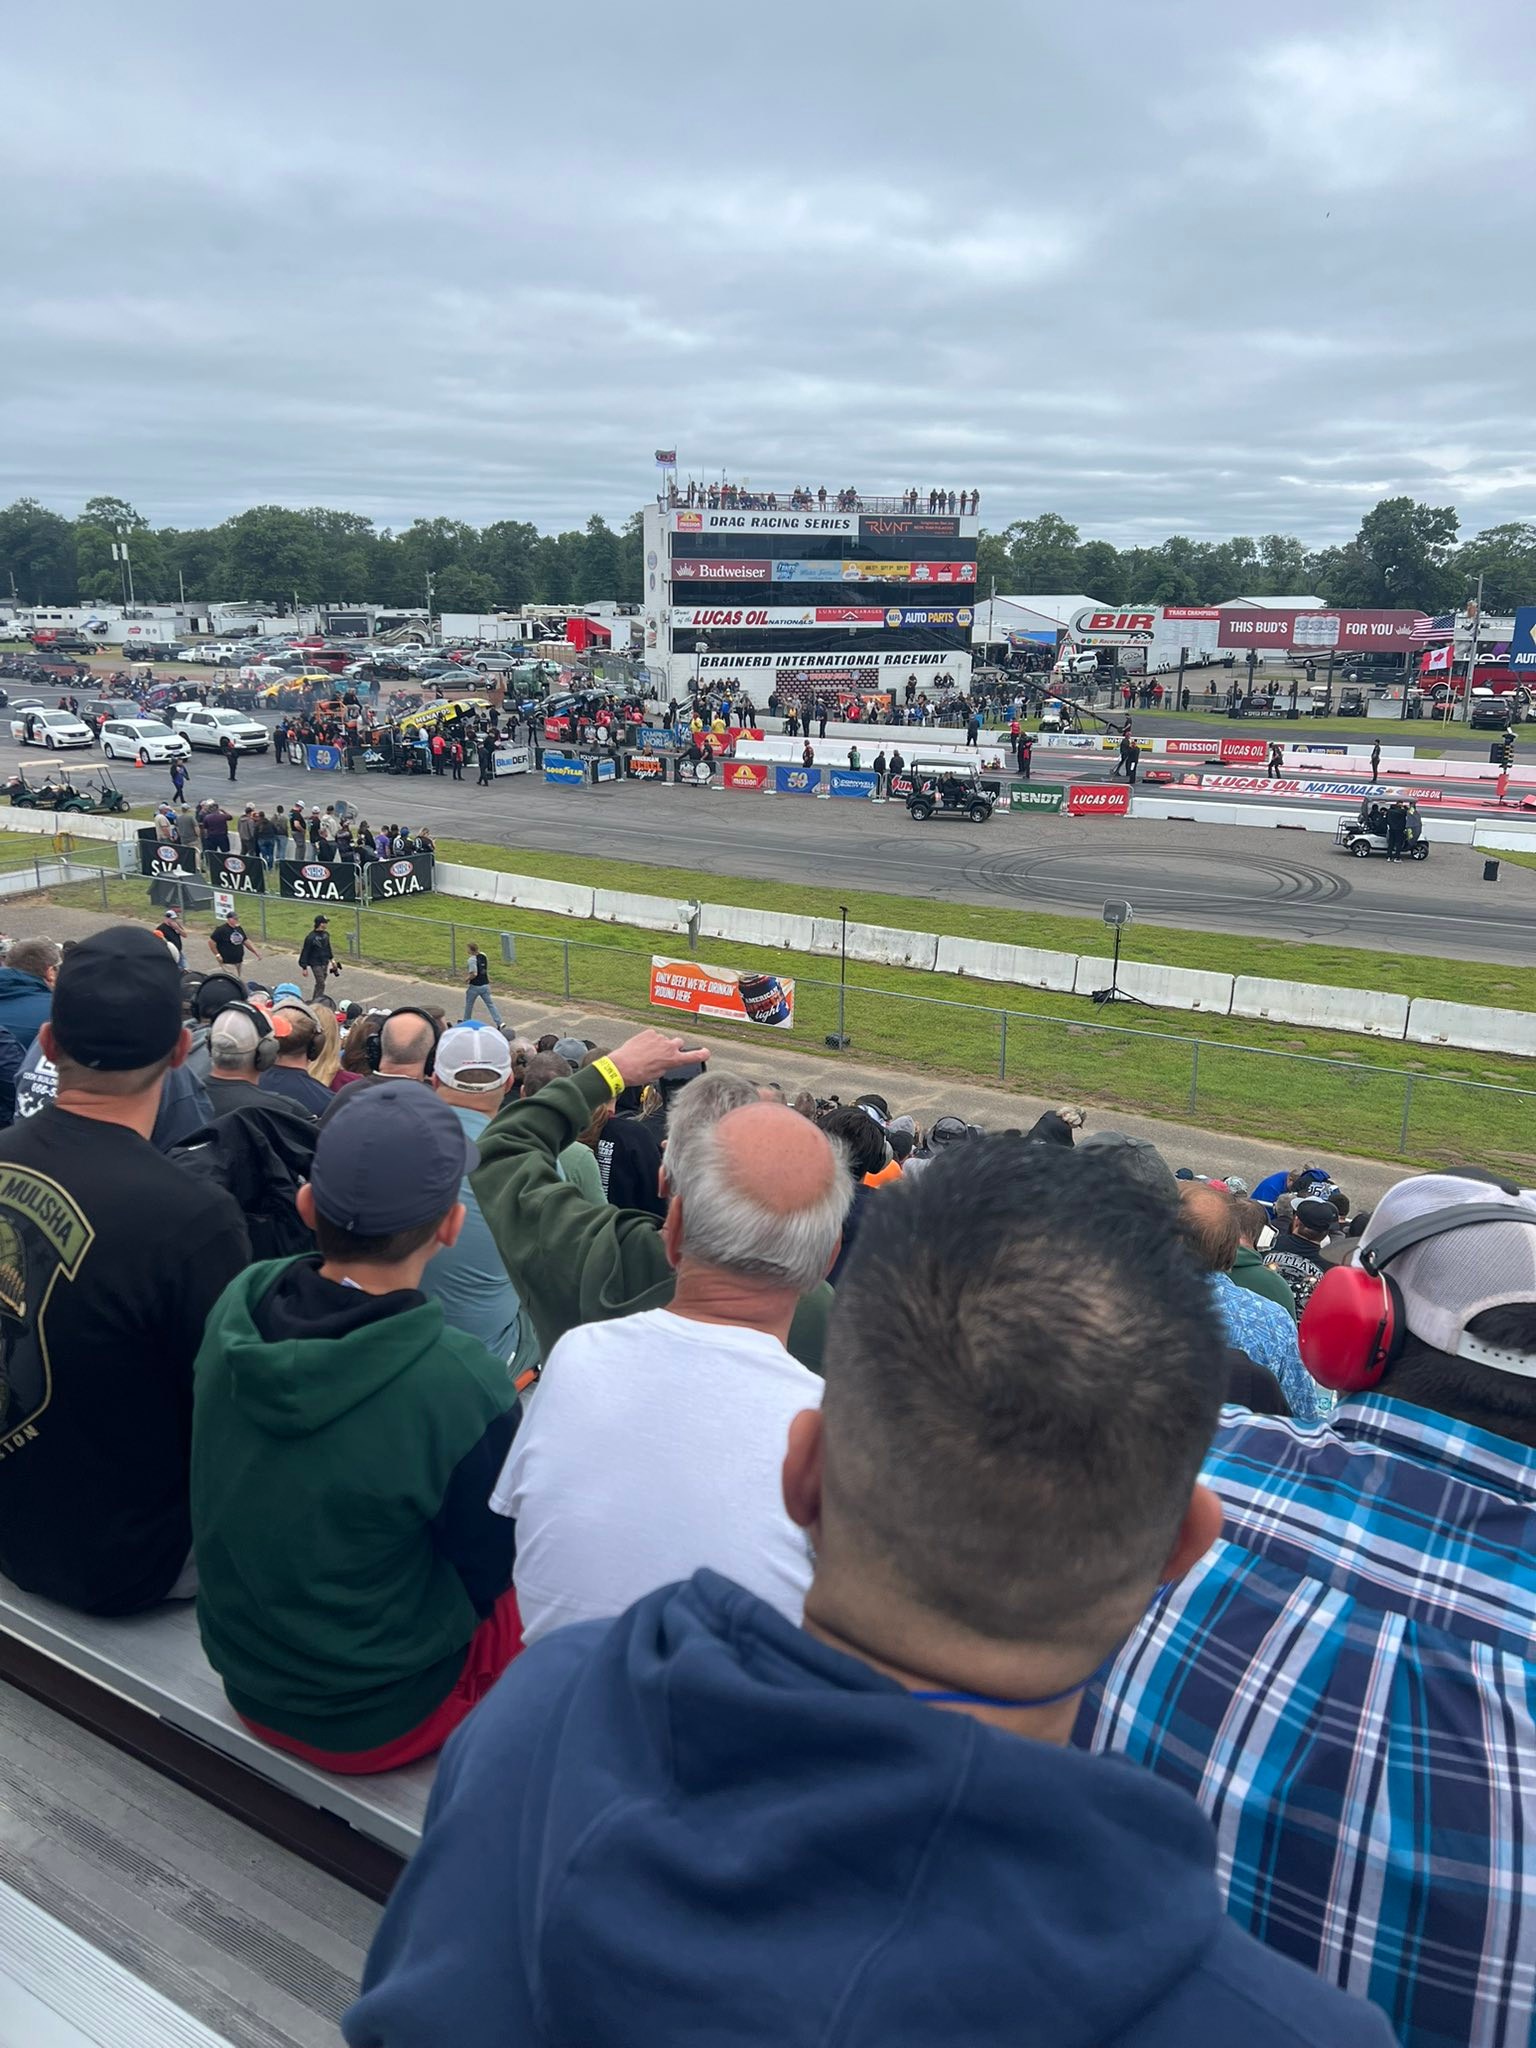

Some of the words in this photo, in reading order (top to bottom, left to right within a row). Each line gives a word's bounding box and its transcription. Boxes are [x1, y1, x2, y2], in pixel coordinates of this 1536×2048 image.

[710, 516, 745, 528] DRAG
[751, 518, 799, 528] RACING
[804, 518, 850, 529] SERIES
[699, 564, 766, 578] Budweiser
[692, 610, 743, 625] LUCAS
[746, 610, 768, 626] OIL
[888, 613, 902, 622] NAPA
[904, 612, 927, 623] AUTO
[928, 612, 954, 623] PARTS
[1088, 614, 1156, 629] BIR
[1230, 621, 1253, 633] THIS
[1256, 622, 1288, 634] BUD'S
[1346, 623, 1367, 635] FOR
[1370, 624, 1393, 636] YOU
[700, 656, 772, 668] BRAINERD
[776, 654, 880, 666] INTERNATIONAL
[884, 654, 948, 665] RACEWAY
[1514, 652, 1536, 664] AUT
[642, 730, 670, 739] CAMPING
[1179, 742, 1218, 752] mission
[1224, 744, 1249, 756] LUCAS
[1250, 745, 1264, 756] OIL
[546, 766, 584, 776] GOODYEAR
[630, 760, 663, 771] REBEL
[1212, 776, 1272, 789] LUCAS
[1272, 780, 1300, 791] OIL
[1304, 782, 1386, 796] NATIONALS
[1012, 791, 1062, 804] FENDT
[1073, 795, 1105, 804] LUCAS
[1108, 795, 1124, 804] OIL
[1408, 790, 1427, 798] LUCAS
[220, 872, 257, 892] S.V.A.
[383, 875, 424, 897] S.V.A.
[293, 880, 344, 900] S.V.A.
[656, 972, 671, 984] ONLY
[671, 975, 686, 988] BEER
[687, 978, 707, 991] WE'RE
[676, 990, 692, 1003] HERE
[745, 986, 779, 1004] AMERICAN
[2, 1178, 75, 1248] MULISHA
